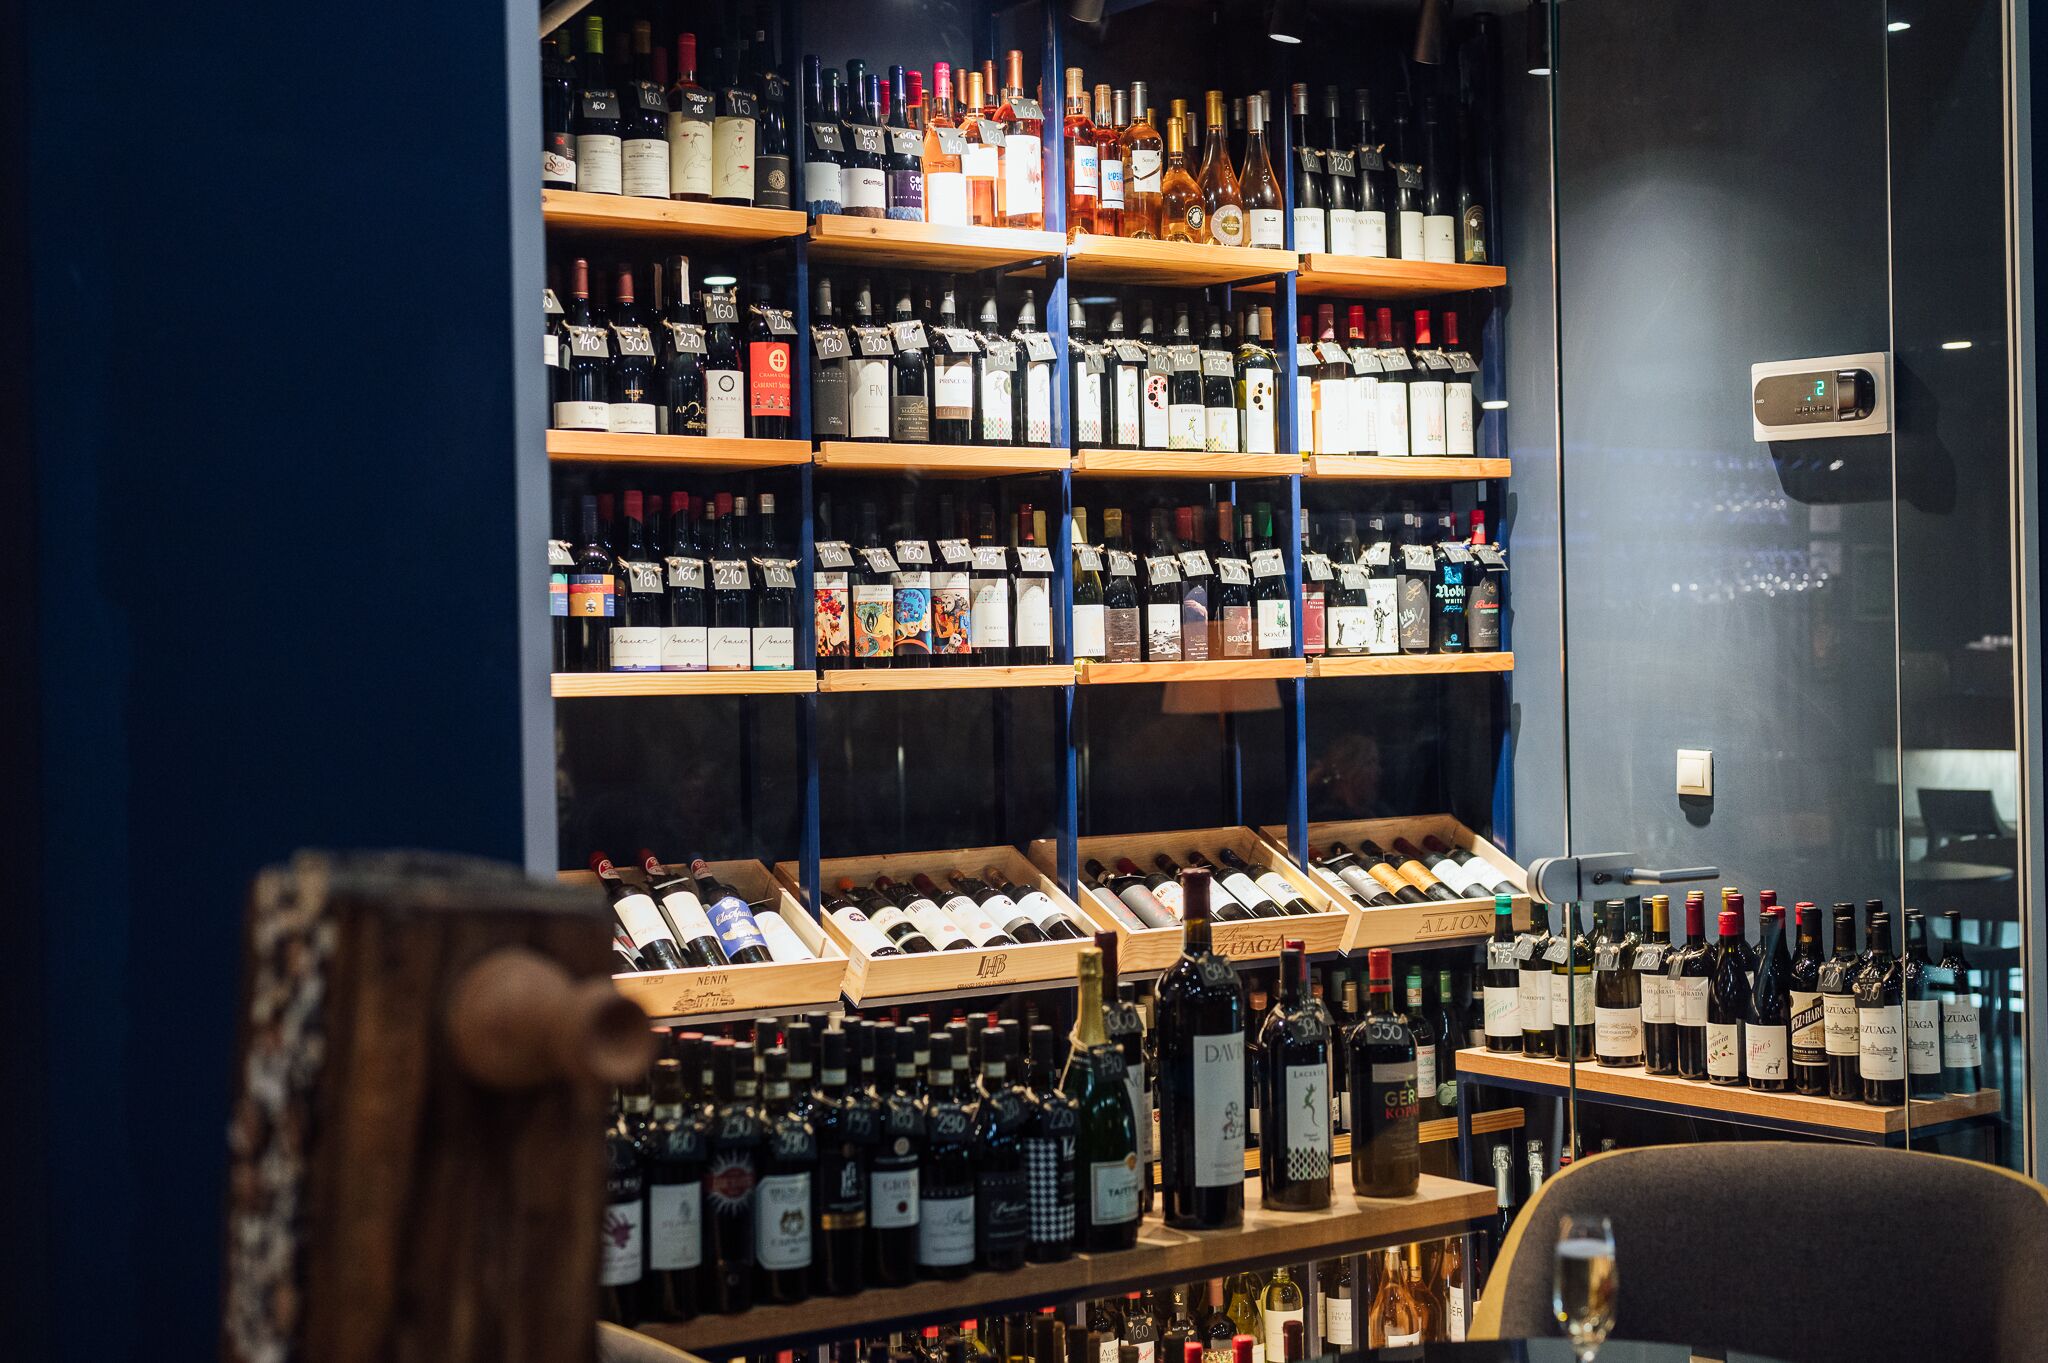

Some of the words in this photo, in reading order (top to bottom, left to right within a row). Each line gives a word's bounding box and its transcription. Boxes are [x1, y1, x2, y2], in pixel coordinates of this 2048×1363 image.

[947, 140, 962, 154] 140
[1331, 156, 1352, 173] 120
[712, 304, 734, 320] 160
[579, 336, 601, 351] 140
[625, 337, 649, 352] 300
[680, 331, 700, 349] 270
[822, 339, 843, 354] 190
[866, 335, 887, 352] 300
[1154, 355, 1170, 372] 120
[1173, 353, 1193, 366] 140
[1208, 358, 1228, 372] 135
[753, 381, 778, 389] CABERNET
[1815, 380, 1825, 396] 2
[824, 548, 843, 563] 140
[903, 547, 923, 560] 160
[945, 545, 966, 559] 200
[1409, 550, 1432, 566] 220
[676, 566, 697, 581] 160
[1155, 563, 1174, 580] 130
[1257, 558, 1278, 574] 155
[637, 571, 657, 588] 180
[718, 568, 742, 585] 210
[770, 568, 790, 583] 130
[1417, 914, 1493, 934] ALION
[1495, 949, 1512, 964] 175
[1638, 953, 1657, 967] 150
[1205, 963, 1234, 980] 890
[696, 975, 729, 987] NENIN
[1131, 1324, 1149, 1340] 160
